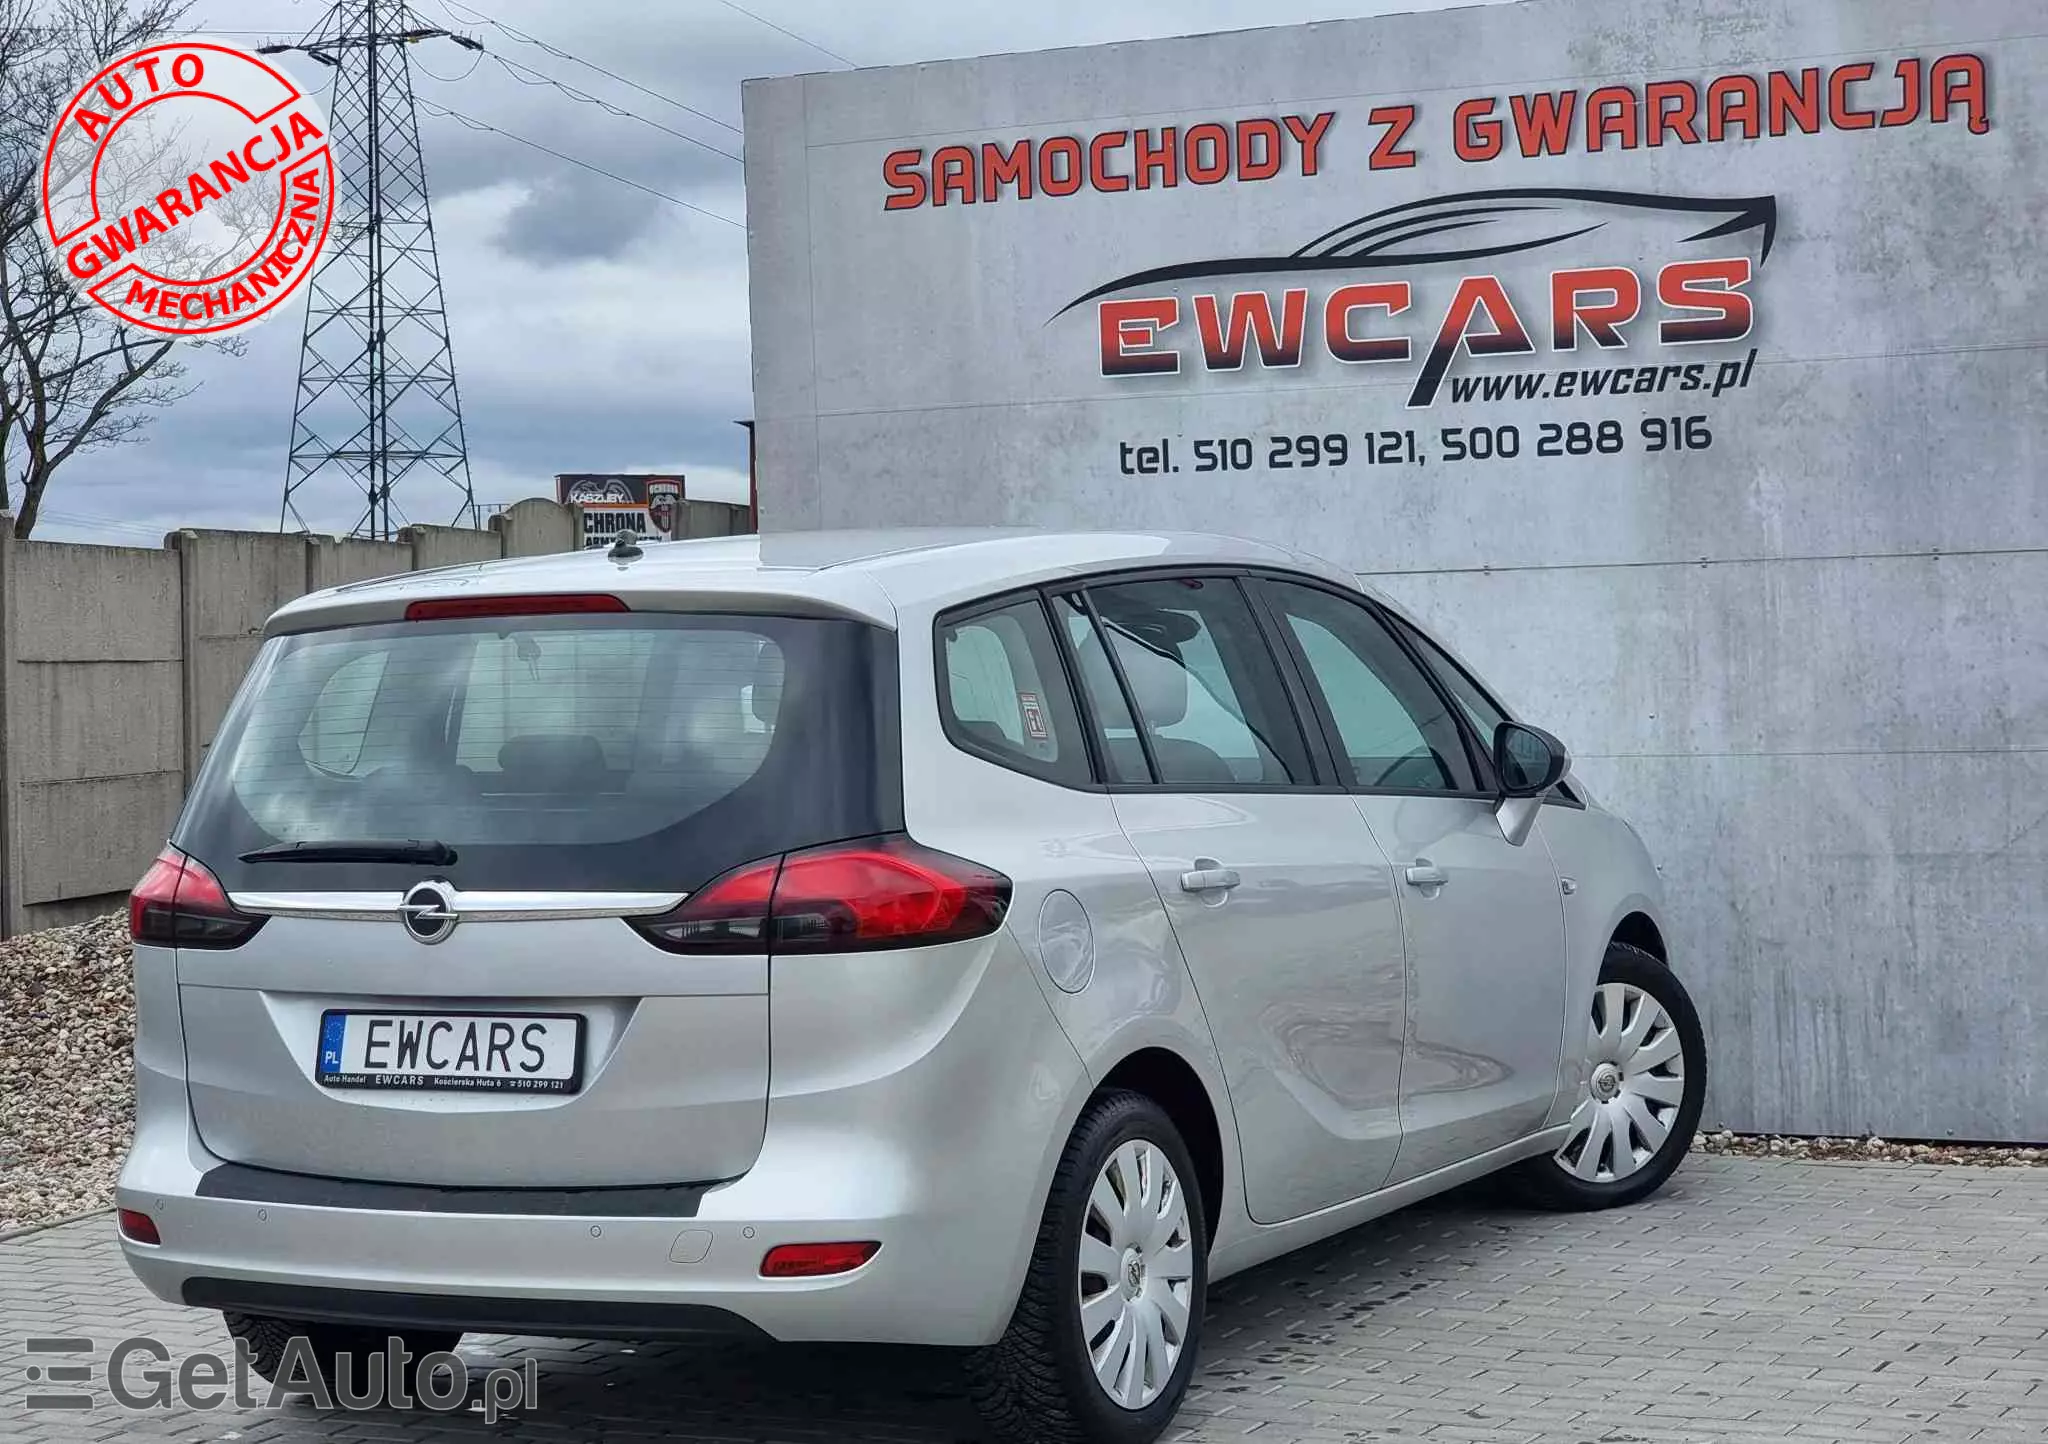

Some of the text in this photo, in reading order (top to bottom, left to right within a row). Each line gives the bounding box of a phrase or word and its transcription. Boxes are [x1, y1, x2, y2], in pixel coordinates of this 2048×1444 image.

[883, 53, 1990, 211] SAMOCHODY Z GWARANCJĄ
[1099, 256, 1753, 409] EWCARS
[1451, 348, 1758, 404] www.ewcars.pl
[1120, 415, 1713, 475] tel. 510 299 121, 500 288 916
[324, 1051, 339, 1065] PL
[364, 1019, 548, 1073] EWCARS
[324, 1074, 340, 1083] Auto
[342, 1075, 367, 1084] Handel
[375, 1075, 425, 1086] EWCARS
[476, 1079, 495, 1088] Huta
[517, 1080, 531, 1088] 510
[551, 1081, 565, 1089] 121
